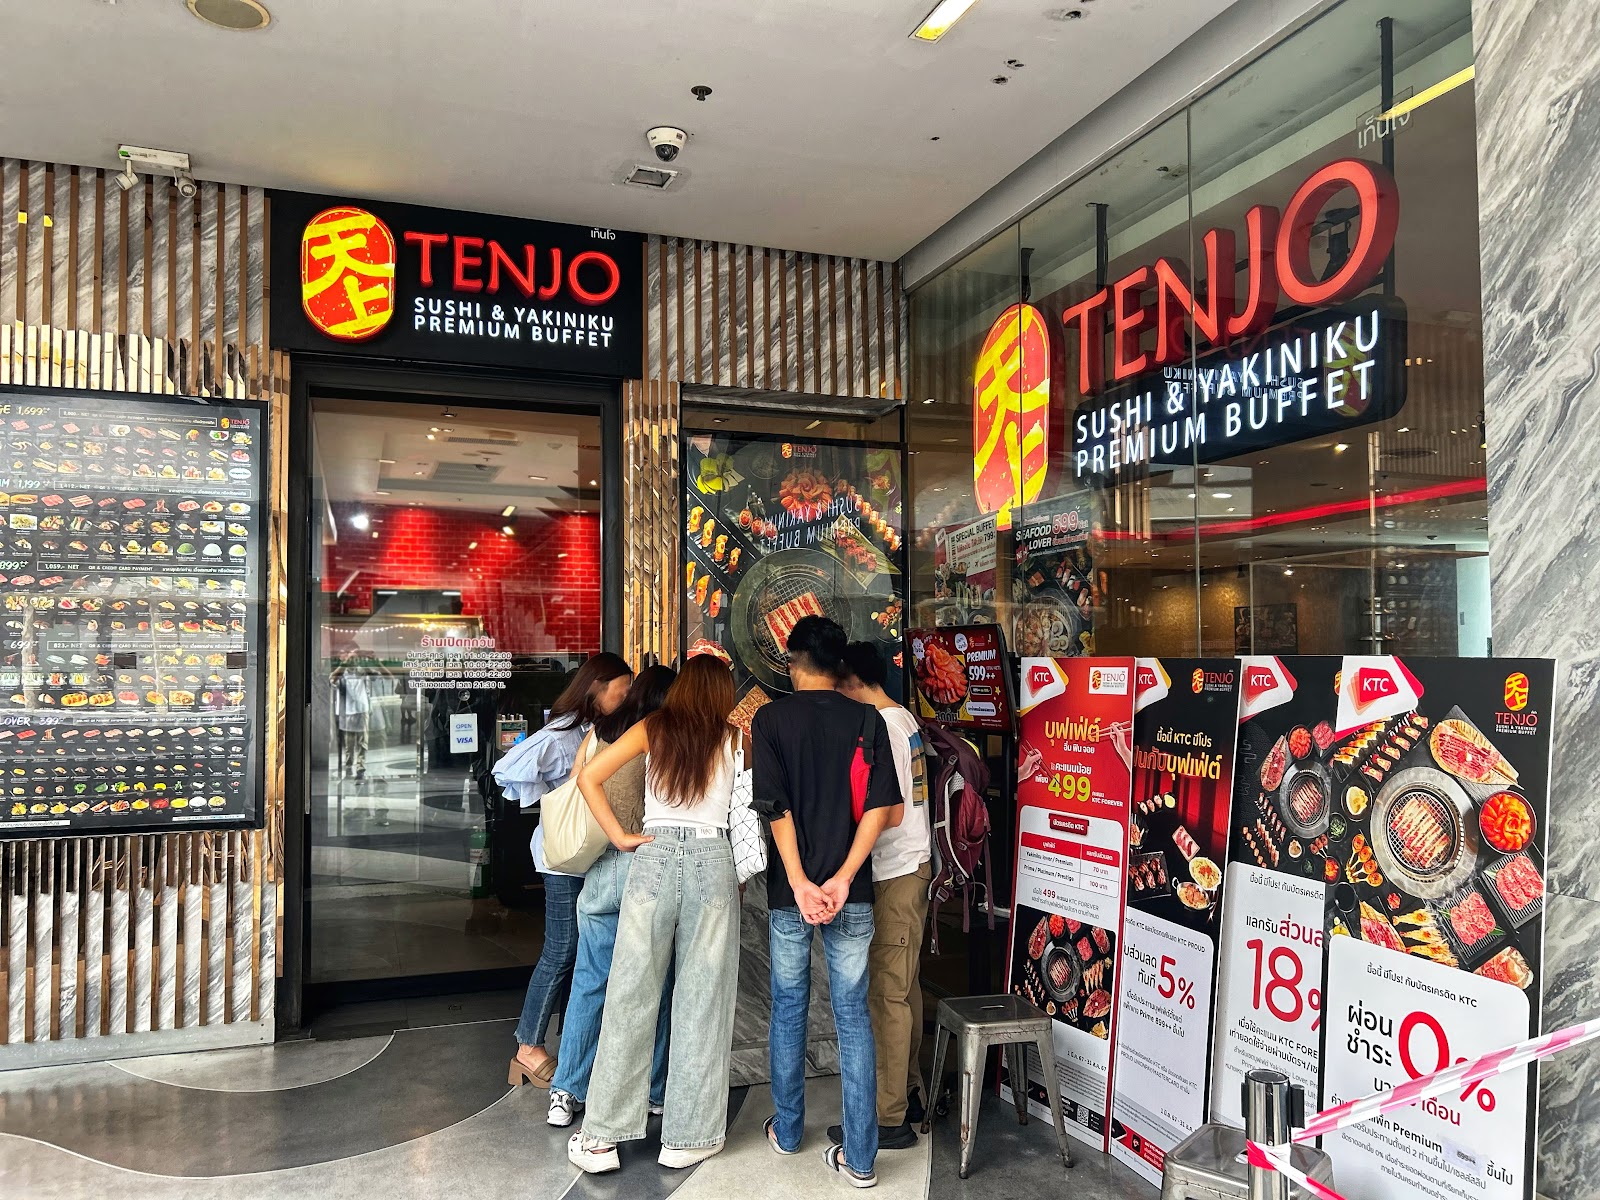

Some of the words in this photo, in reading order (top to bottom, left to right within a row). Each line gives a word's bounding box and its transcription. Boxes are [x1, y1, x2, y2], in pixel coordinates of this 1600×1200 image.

[403, 230, 621, 305] TENJO
[1062, 158, 1398, 396] TENJO
[414, 297, 482, 319] SUSHI
[492, 305, 505, 321] &
[513, 307, 615, 332] YAKINIKU
[414, 313, 520, 340] PREMIUM
[531, 326, 612, 348] BUFFET
[1076, 391, 1152, 443] SUSHI
[1167, 381, 1185, 415] &
[1197, 309, 1378, 404] YAKINIKU
[1077, 413, 1206, 478] PREMIUM
[1226, 359, 1376, 438] BUFFET
[976, 518, 995, 534] BUFFET
[1052, 510, 1079, 535] 599
[1029, 537, 1052, 550] LOVER
[421, 635, 496, 650] ร้านเปิดทุกวัน
[966, 648, 996, 663] PREMIUM
[1034, 672, 1050, 682] KTC
[1102, 673, 1125, 682] TENJO
[1138, 674, 1153, 684] KTC
[1205, 672, 1234, 684] TENJO
[1250, 674, 1272, 687] KTC
[1363, 677, 1390, 692] KTC
[1495, 712, 1538, 726] TENJO
[1045, 716, 1101, 746] บุฟเฟ่ต์
[1174, 733, 1192, 745] KTC
[1082, 745, 1095, 753] จอย
[1048, 773, 1091, 802] 499
[1101, 799, 1124, 807] FOREVER
[1075, 822, 1085, 831] KTC
[1023, 864, 1034, 873] Prime
[1055, 857, 1074, 867] Premium
[1089, 880, 1099, 888] 100
[1043, 888, 1056, 899] 499
[1078, 901, 1100, 911] FOREVER
[1246, 915, 1278, 934] แลกรับ
[1279, 913, 1323, 947] ส่วนล
[1178, 937, 1187, 946] KTC
[1187, 941, 1206, 953] PROUD
[1137, 968, 1156, 989] ทันที
[1157, 954, 1196, 1010] 5%
[1367, 962, 1382, 977] มื้อนี้
[1405, 977, 1456, 1001] กับบัตรเครดิต
[1459, 995, 1478, 1008] KTC
[1140, 1009, 1155, 1022] Prime
[1348, 1000, 1393, 1038] ผ่อน
[1278, 1035, 1295, 1049] KTC
[1295, 1043, 1319, 1060] FORE
[1347, 1029, 1392, 1067] ชำระ
[1393, 1122, 1443, 1154] Premium
[1487, 1160, 1513, 1186] ขึ้นไป
[1412, 1149, 1418, 1157] 2
